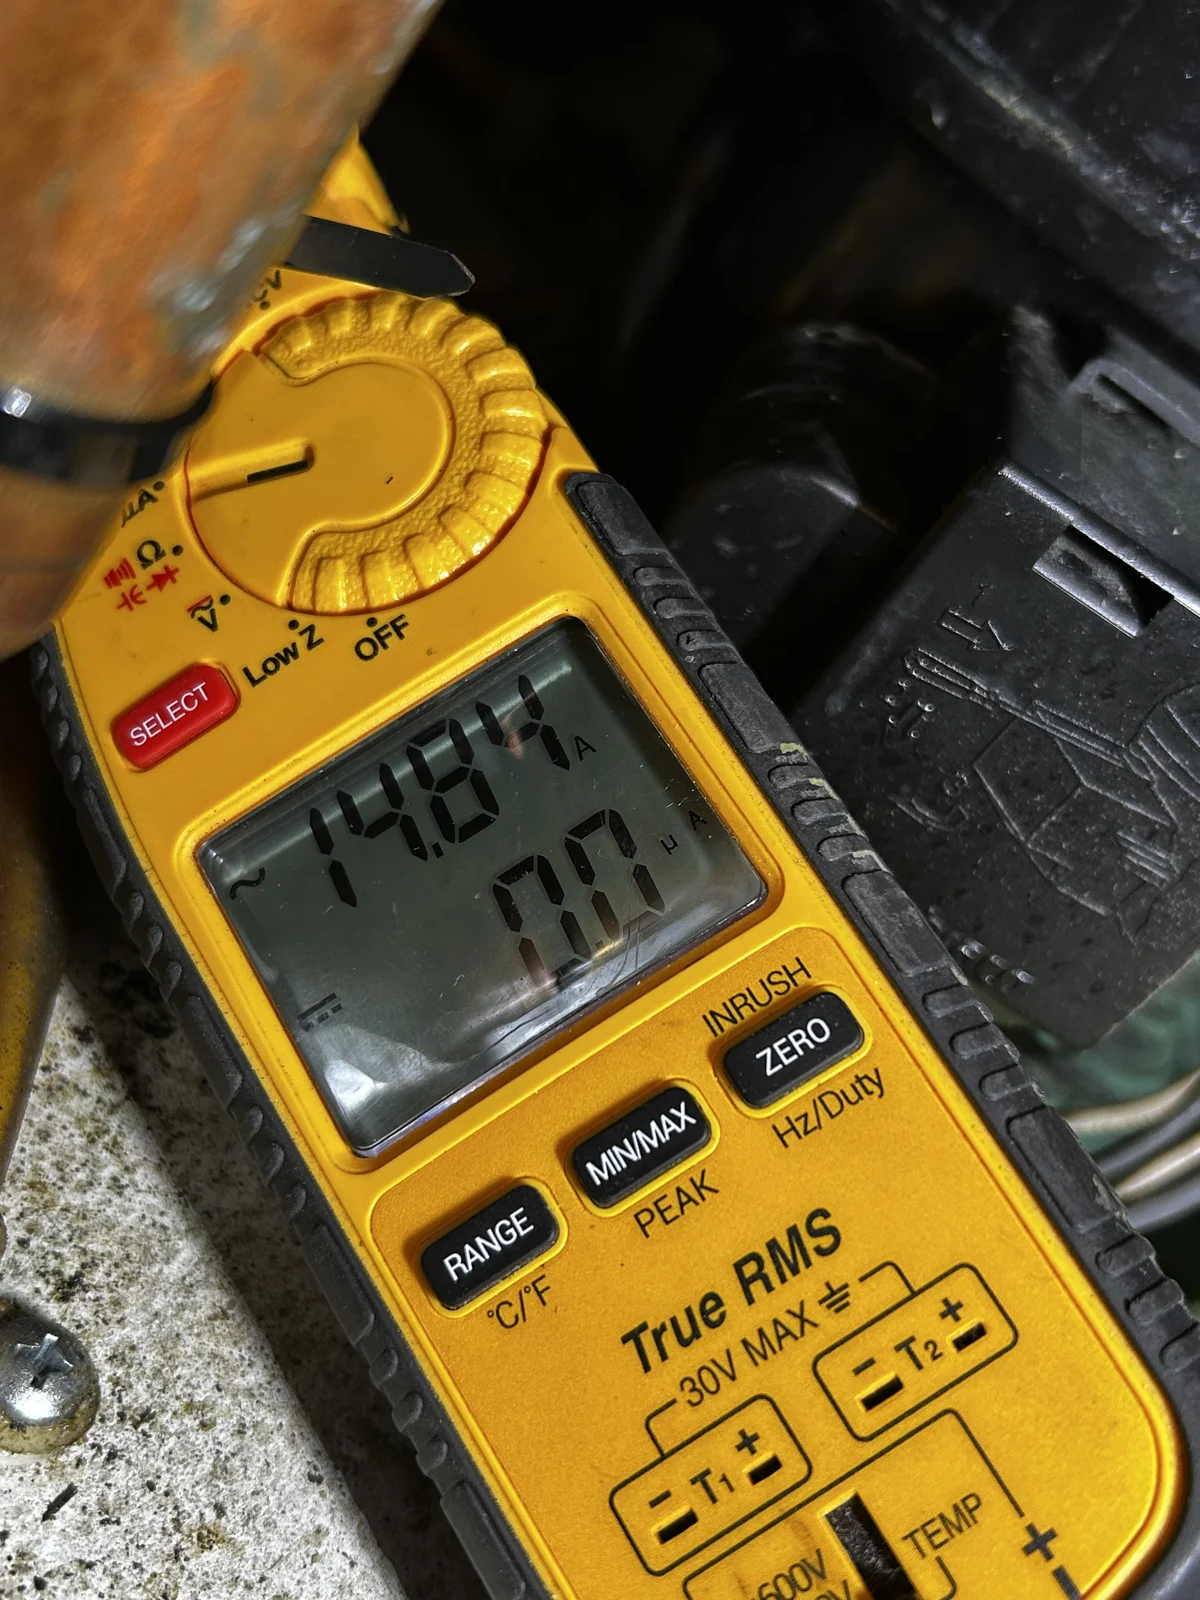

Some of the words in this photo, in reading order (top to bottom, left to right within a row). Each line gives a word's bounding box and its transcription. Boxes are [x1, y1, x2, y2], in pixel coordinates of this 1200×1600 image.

[354, 613, 410, 662] OFF
[129, 681, 211, 747] SELECT
[309, 674, 570, 909] 14.84
[574, 734, 597, 762] A
[701, 956, 813, 1038] INRUSH
[755, 1016, 832, 1077] ZERO
[584, 1100, 698, 1187] MIN/MAX
[771, 1066, 886, 1149] Hz/Duty
[632, 1168, 720, 1240] PEAK
[442, 1207, 535, 1282] RANGE
[486, 1274, 554, 1331] °C/°F
[620, 1290, 726, 1374] True
[732, 1207, 842, 1306] RMS
[679, 1349, 738, 1407] 30V
[740, 1299, 820, 1368] MAX
[900, 1491, 984, 1561] TEMP
